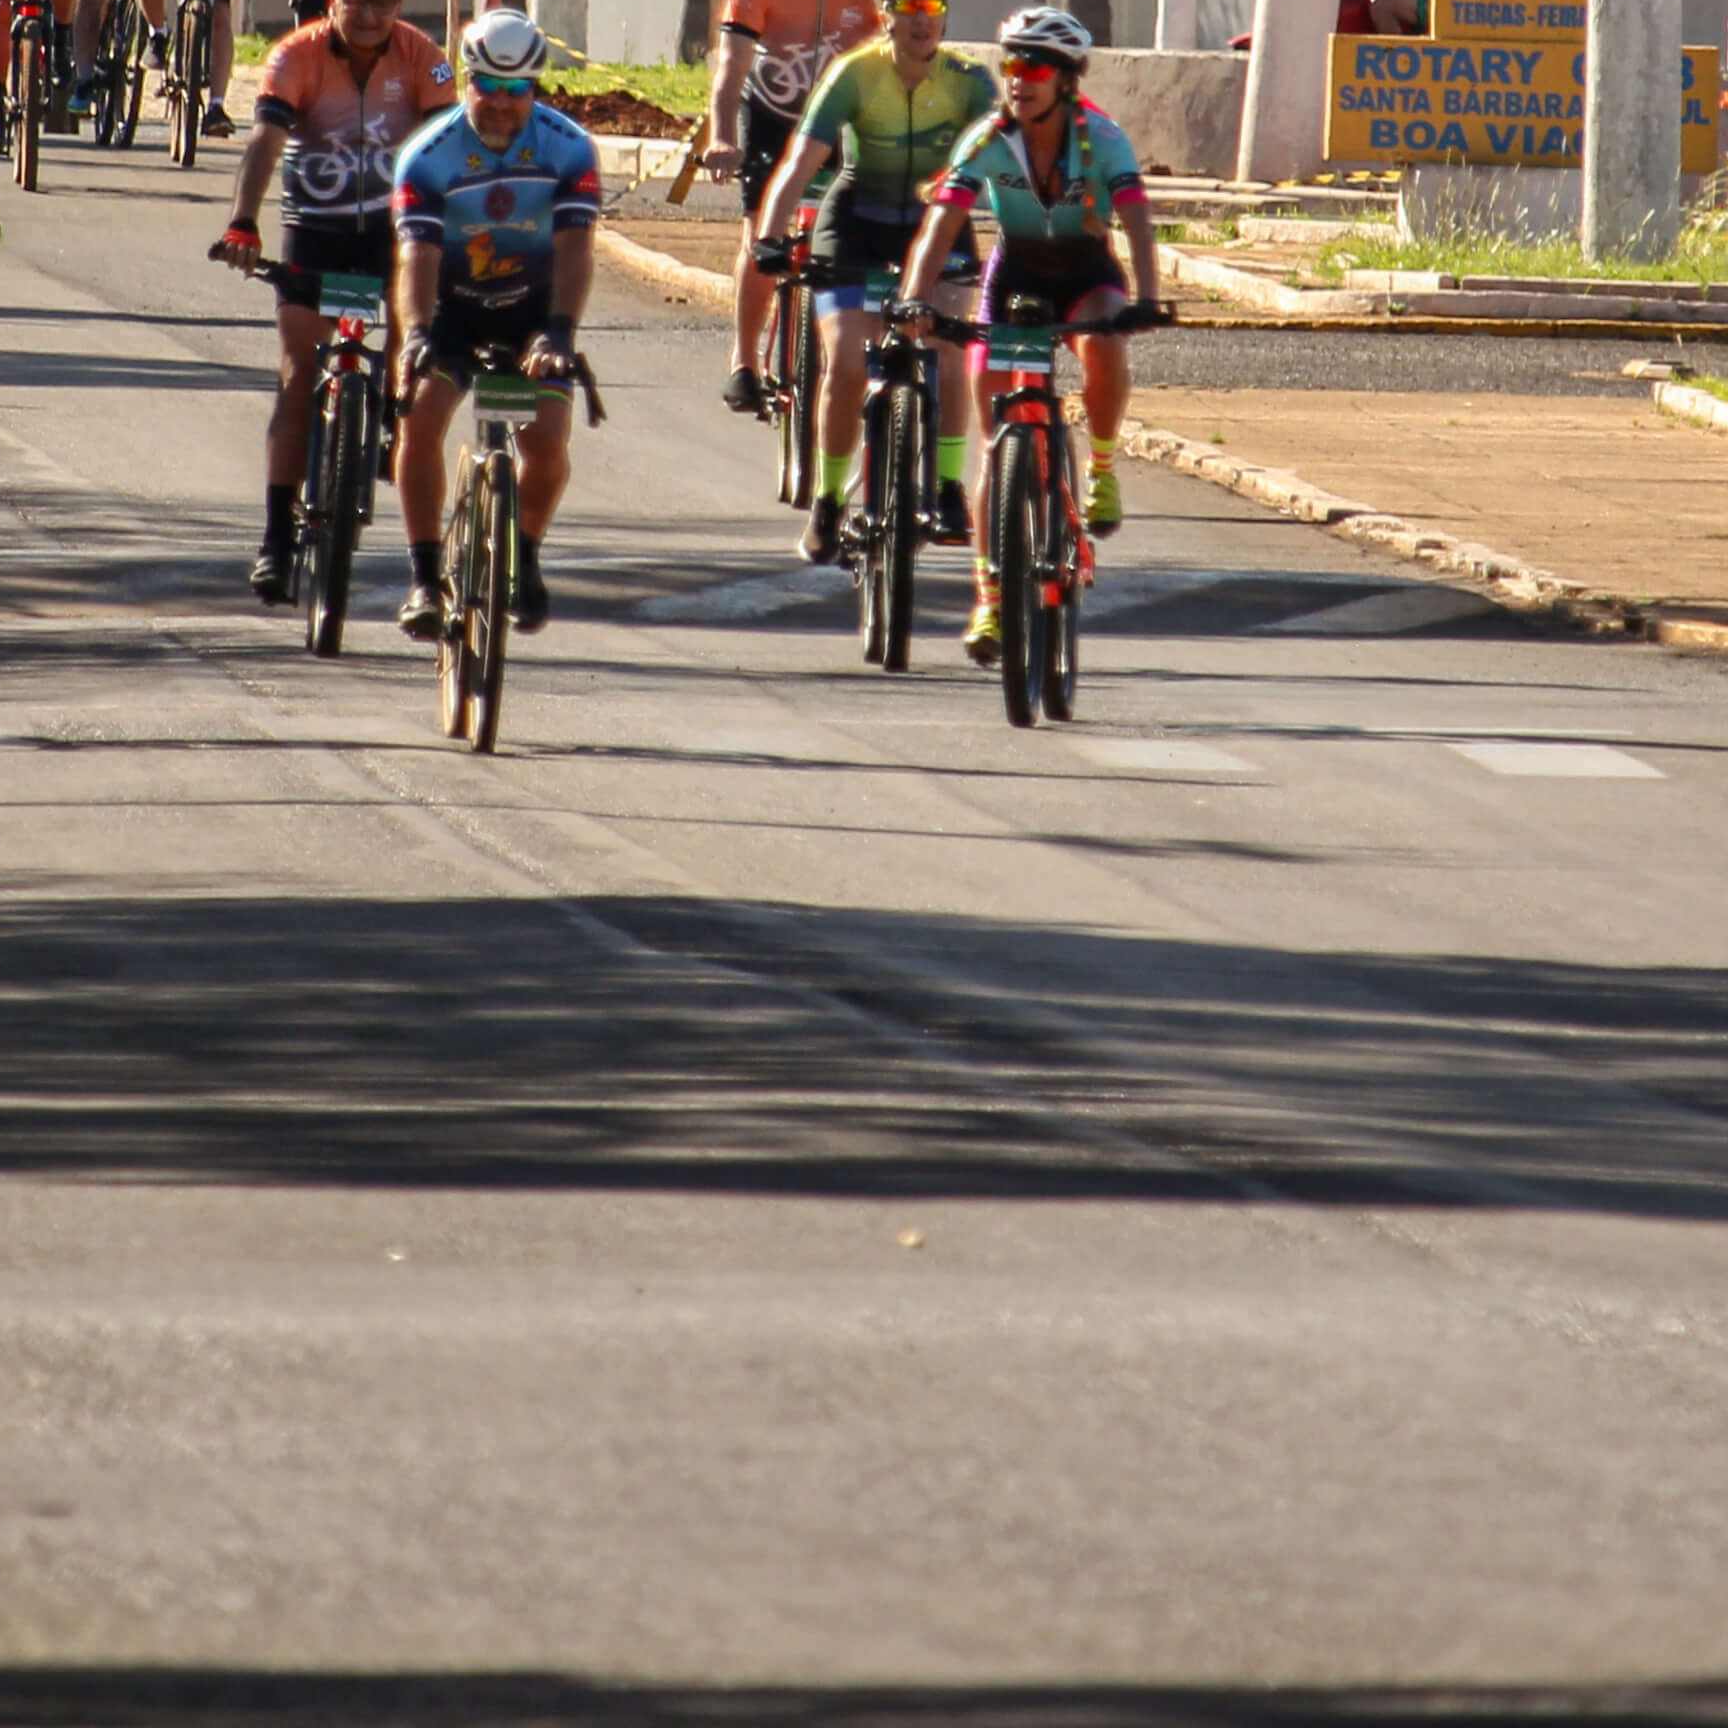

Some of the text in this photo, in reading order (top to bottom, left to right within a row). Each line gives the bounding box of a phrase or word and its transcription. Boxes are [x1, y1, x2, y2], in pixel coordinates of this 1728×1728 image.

[1355, 44, 1542, 85] ROTARY
[1339, 85, 1432, 113] SANTA
[1370, 119, 1469, 152] BOA
